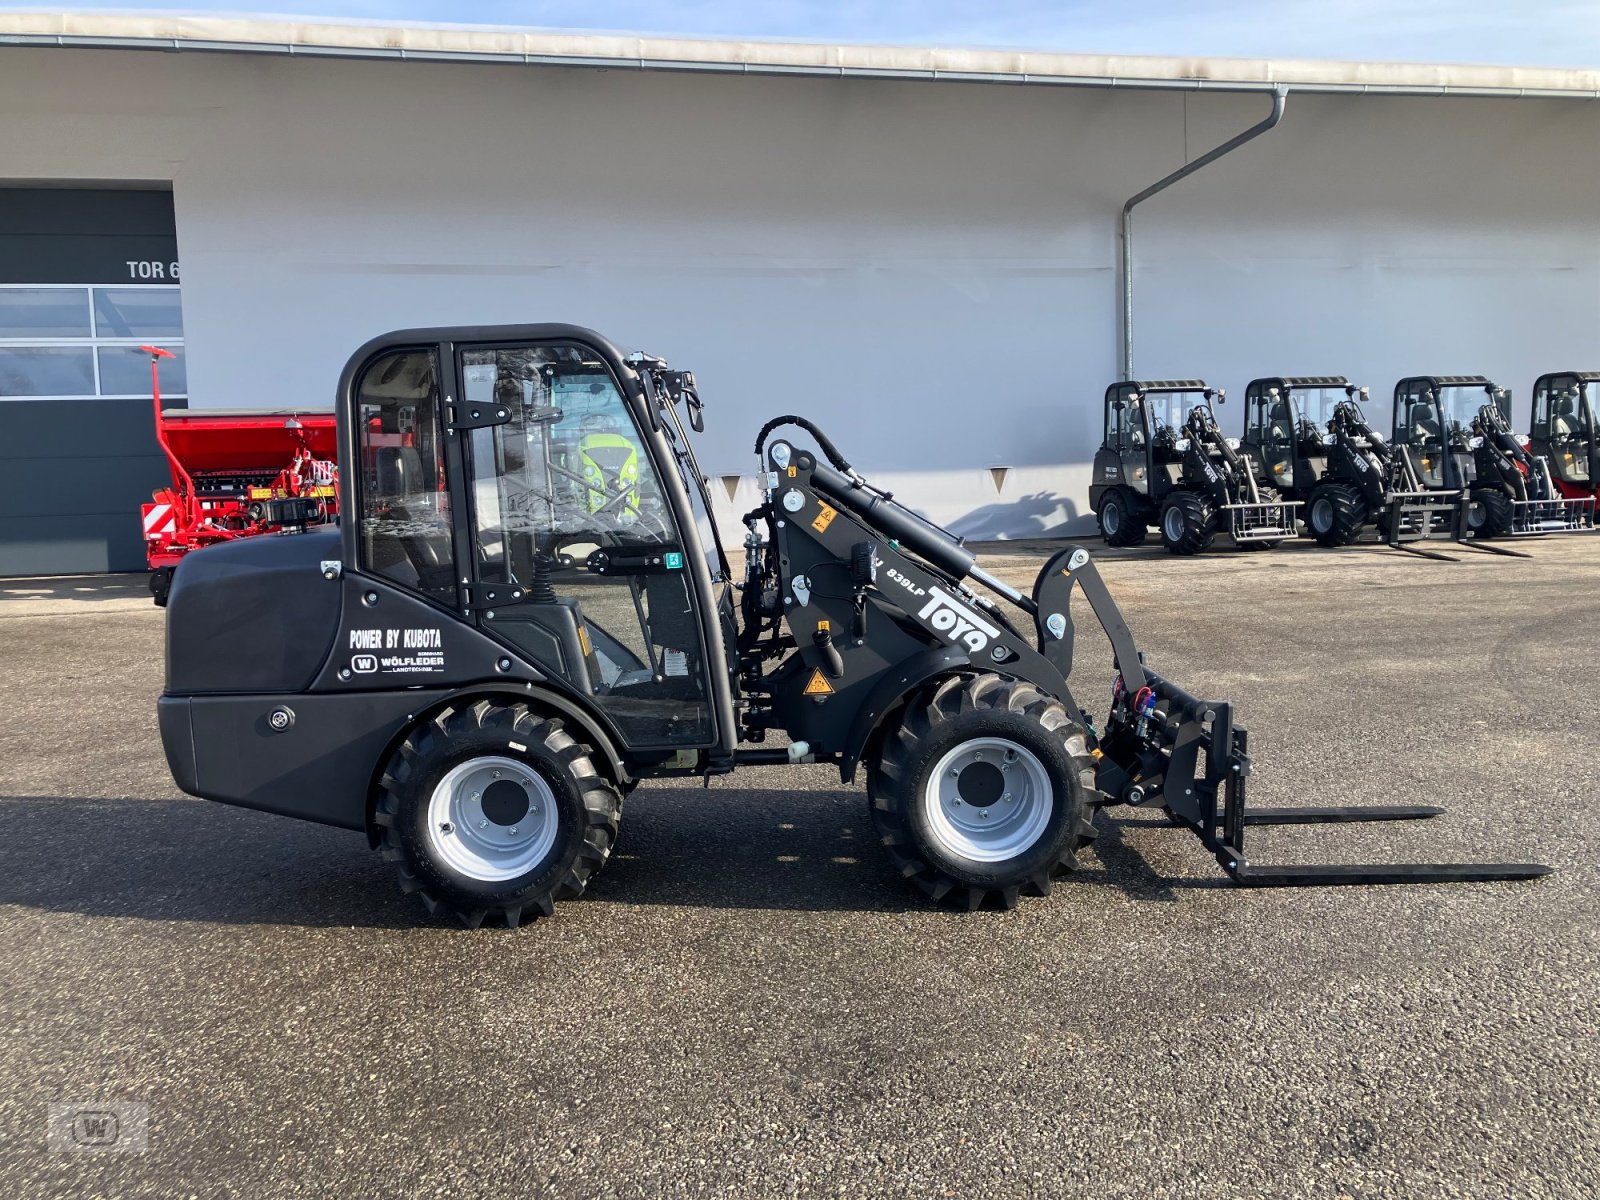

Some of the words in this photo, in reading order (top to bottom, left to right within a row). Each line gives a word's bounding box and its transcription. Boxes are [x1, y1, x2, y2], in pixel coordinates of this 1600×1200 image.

[126, 261, 164, 278] TOR
[169, 261, 180, 278] 6
[1204, 461, 1219, 483] TOYO
[1353, 452, 1370, 473] TOYO
[886, 568, 926, 596] 839LP
[917, 585, 1001, 655] TOYO
[349, 629, 382, 649] POWER
[386, 629, 400, 649] BY
[403, 628, 442, 648] KUBOTA
[357, 658, 372, 669] W
[381, 656, 444, 666] WÖLFLEDER
